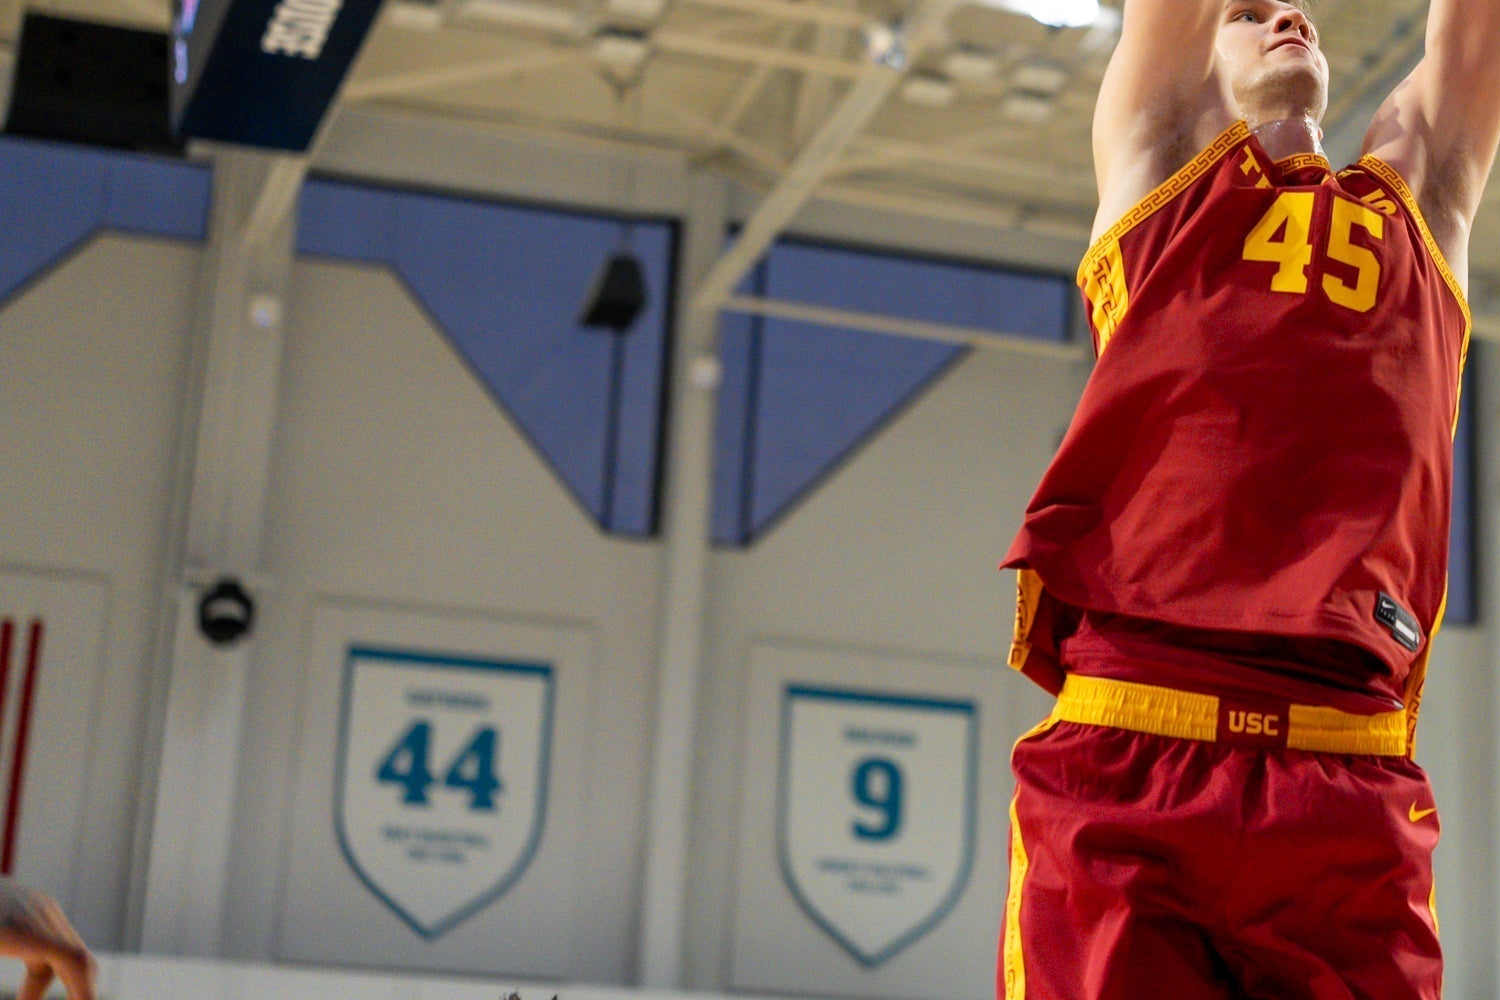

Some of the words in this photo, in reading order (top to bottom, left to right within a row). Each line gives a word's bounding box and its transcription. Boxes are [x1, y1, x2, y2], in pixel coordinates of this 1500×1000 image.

[1242, 191, 1384, 313] 45
[376, 719, 504, 813] 44
[1228, 710, 1279, 736] USC
[852, 756, 905, 842] 9
